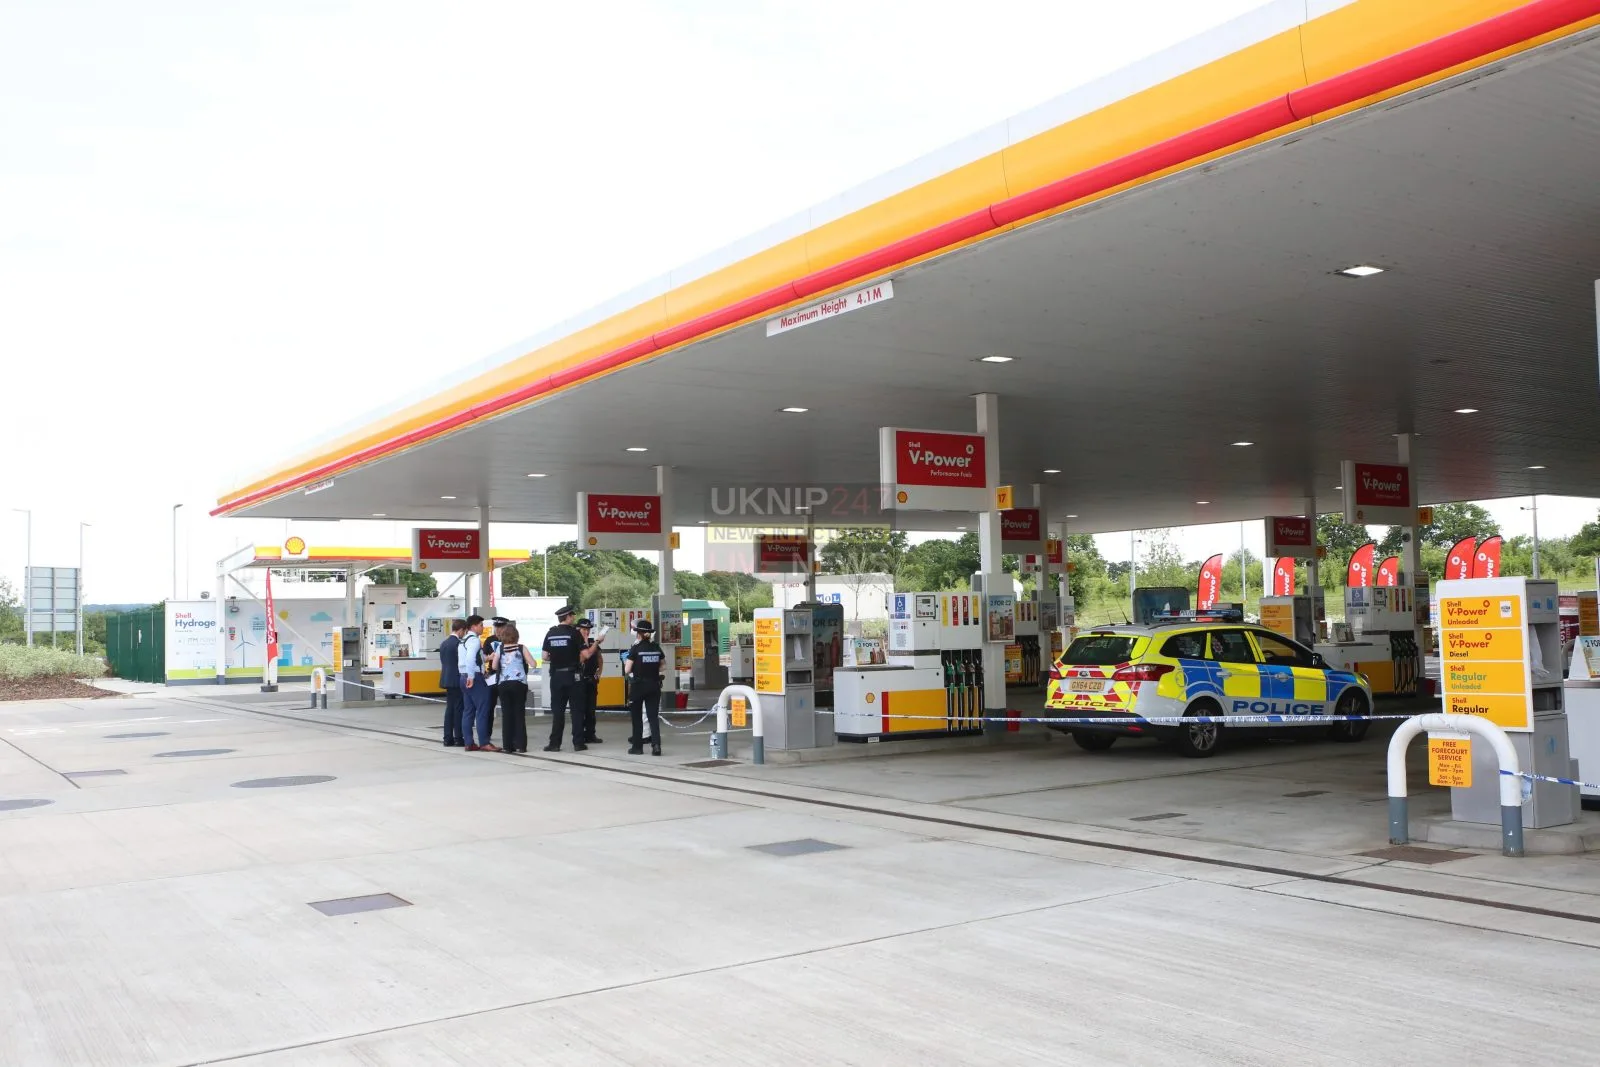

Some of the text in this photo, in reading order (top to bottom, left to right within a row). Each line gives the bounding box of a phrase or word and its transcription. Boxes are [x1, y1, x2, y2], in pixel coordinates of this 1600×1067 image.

[781, 309, 818, 328] Maximum
[821, 298, 848, 316] Height
[908, 449, 972, 468] V-Power
[930, 469, 960, 477] Performance
[1363, 477, 1401, 492] V-Power
[998, 493, 1007, 503] 17
[599, 507, 650, 519] V-Power
[1001, 518, 1032, 529] -Power
[1279, 526, 1305, 536] V-Power
[428, 539, 470, 549] V-Power
[767, 544, 801, 552] V-Power
[1447, 607, 1488, 616] V-Power
[175, 619, 216, 629] Hydroge
[550, 639, 568, 647] POLICE
[1449, 639, 1490, 648] V-Power
[642, 655, 660, 663] POLICE
[1449, 650, 1469, 658] Diesel
[1450, 672, 1487, 682] Regular
[1052, 700, 1117, 708] POLICE
[1232, 700, 1325, 716] POLICE
[1452, 704, 1489, 715] Regular
